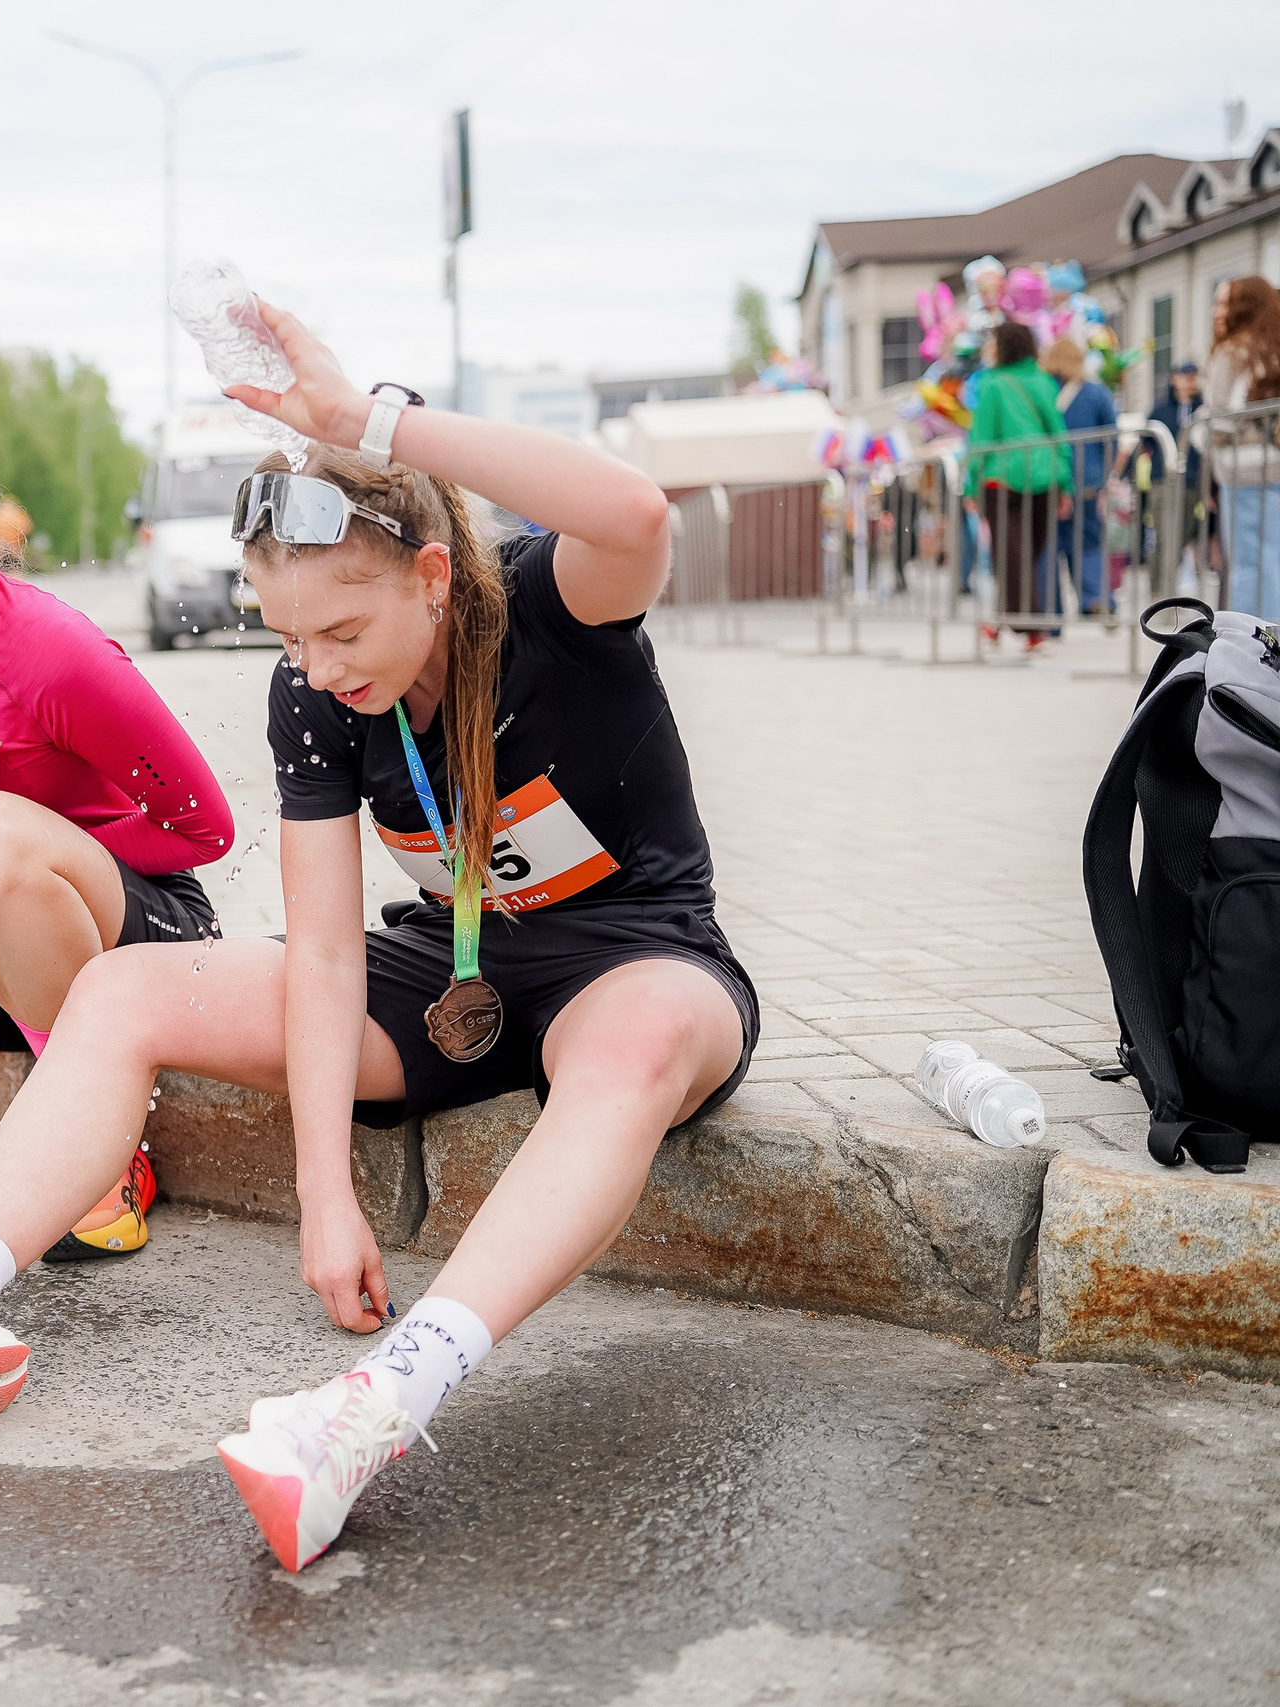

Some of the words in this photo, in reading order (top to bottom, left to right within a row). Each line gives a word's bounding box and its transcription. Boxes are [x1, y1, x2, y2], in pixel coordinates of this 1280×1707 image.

[412, 762, 422, 784] Utair
[411, 839, 434, 847] СБЕР
[476, 1013, 496, 1025] СБЕР
